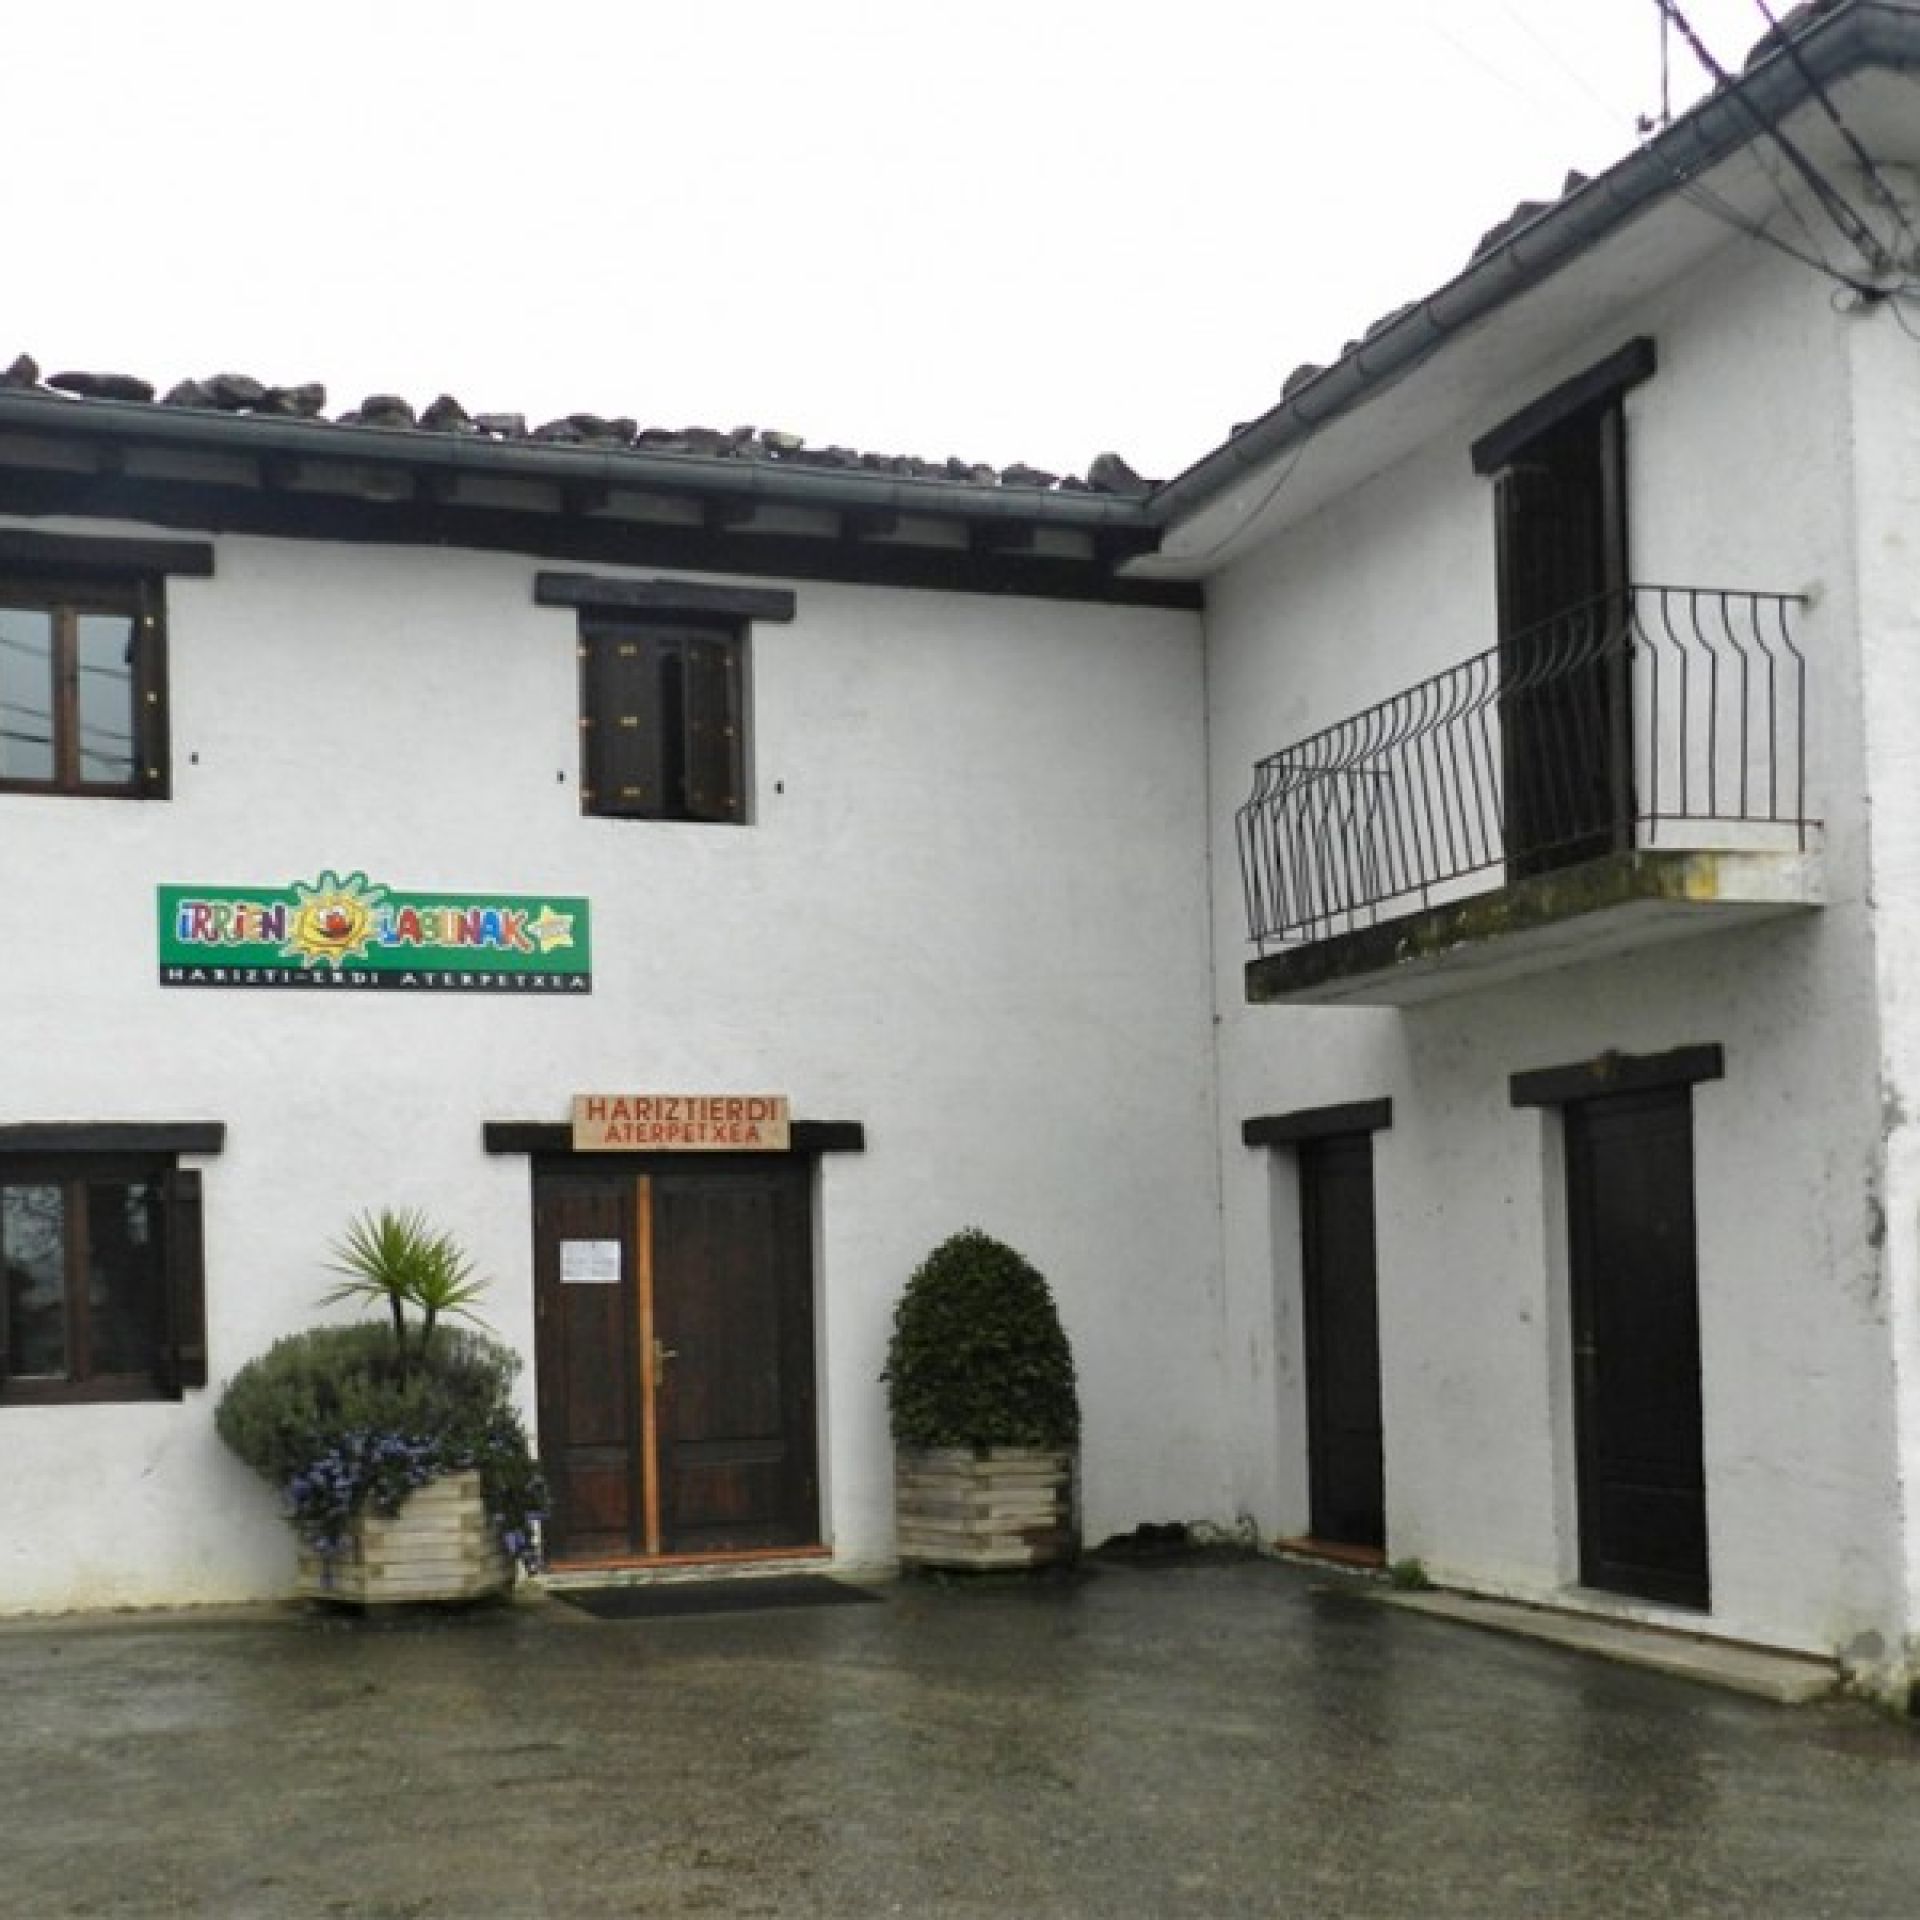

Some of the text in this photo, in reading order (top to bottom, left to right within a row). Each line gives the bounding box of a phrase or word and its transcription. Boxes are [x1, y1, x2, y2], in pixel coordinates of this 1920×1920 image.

[402, 972, 585, 989] ATERPETXEA
[587, 1098, 778, 1121] HARIZTIERDI
[606, 1123, 759, 1143] ATERPETXEA
